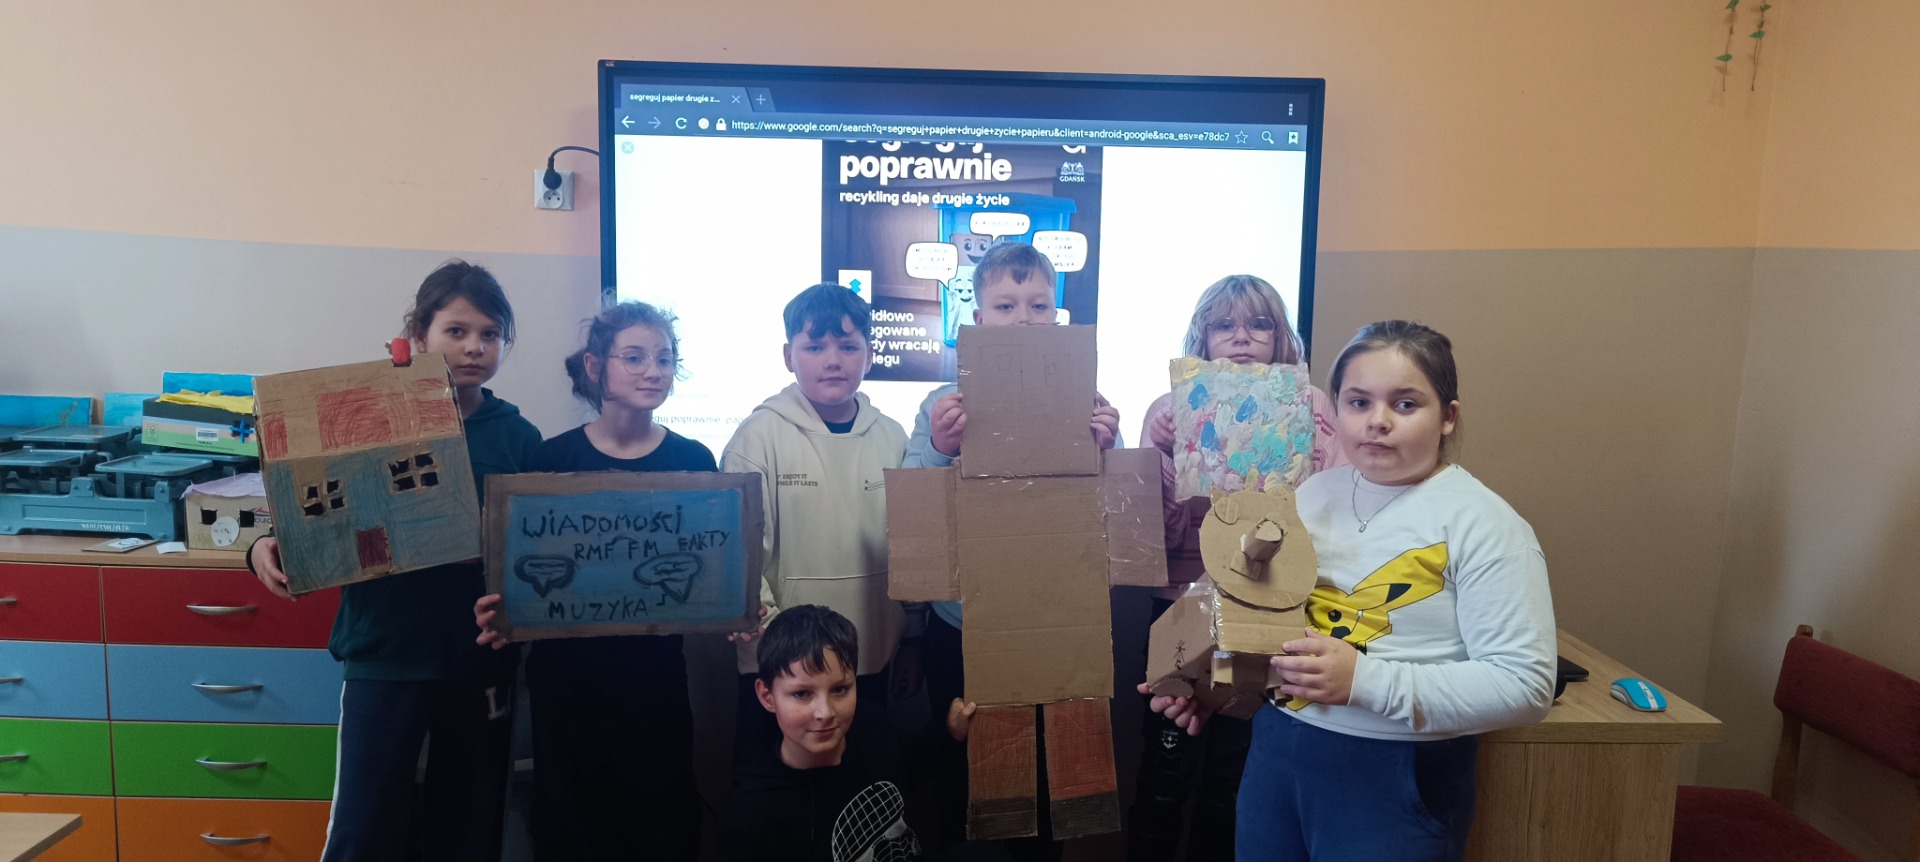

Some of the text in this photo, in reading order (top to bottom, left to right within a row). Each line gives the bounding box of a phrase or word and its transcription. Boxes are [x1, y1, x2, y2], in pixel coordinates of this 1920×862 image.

[629, 93, 661, 103] segreguj
[662, 93, 684, 104] papier
[685, 94, 709, 104] drugie
[839, 152, 1013, 185] poprawnie
[1059, 174, 1085, 183] GDAŃSK
[839, 190, 1010, 208] recykling daje drugie życie
[870, 309, 914, 322] idłowo
[871, 338, 940, 354] dy wracają
[872, 352, 900, 367] iegu
[670, 415, 720, 424] poprawnie
[678, 529, 732, 552] FAKTY
[573, 539, 661, 561] RMF FM
[547, 596, 649, 622] MUZYKA
